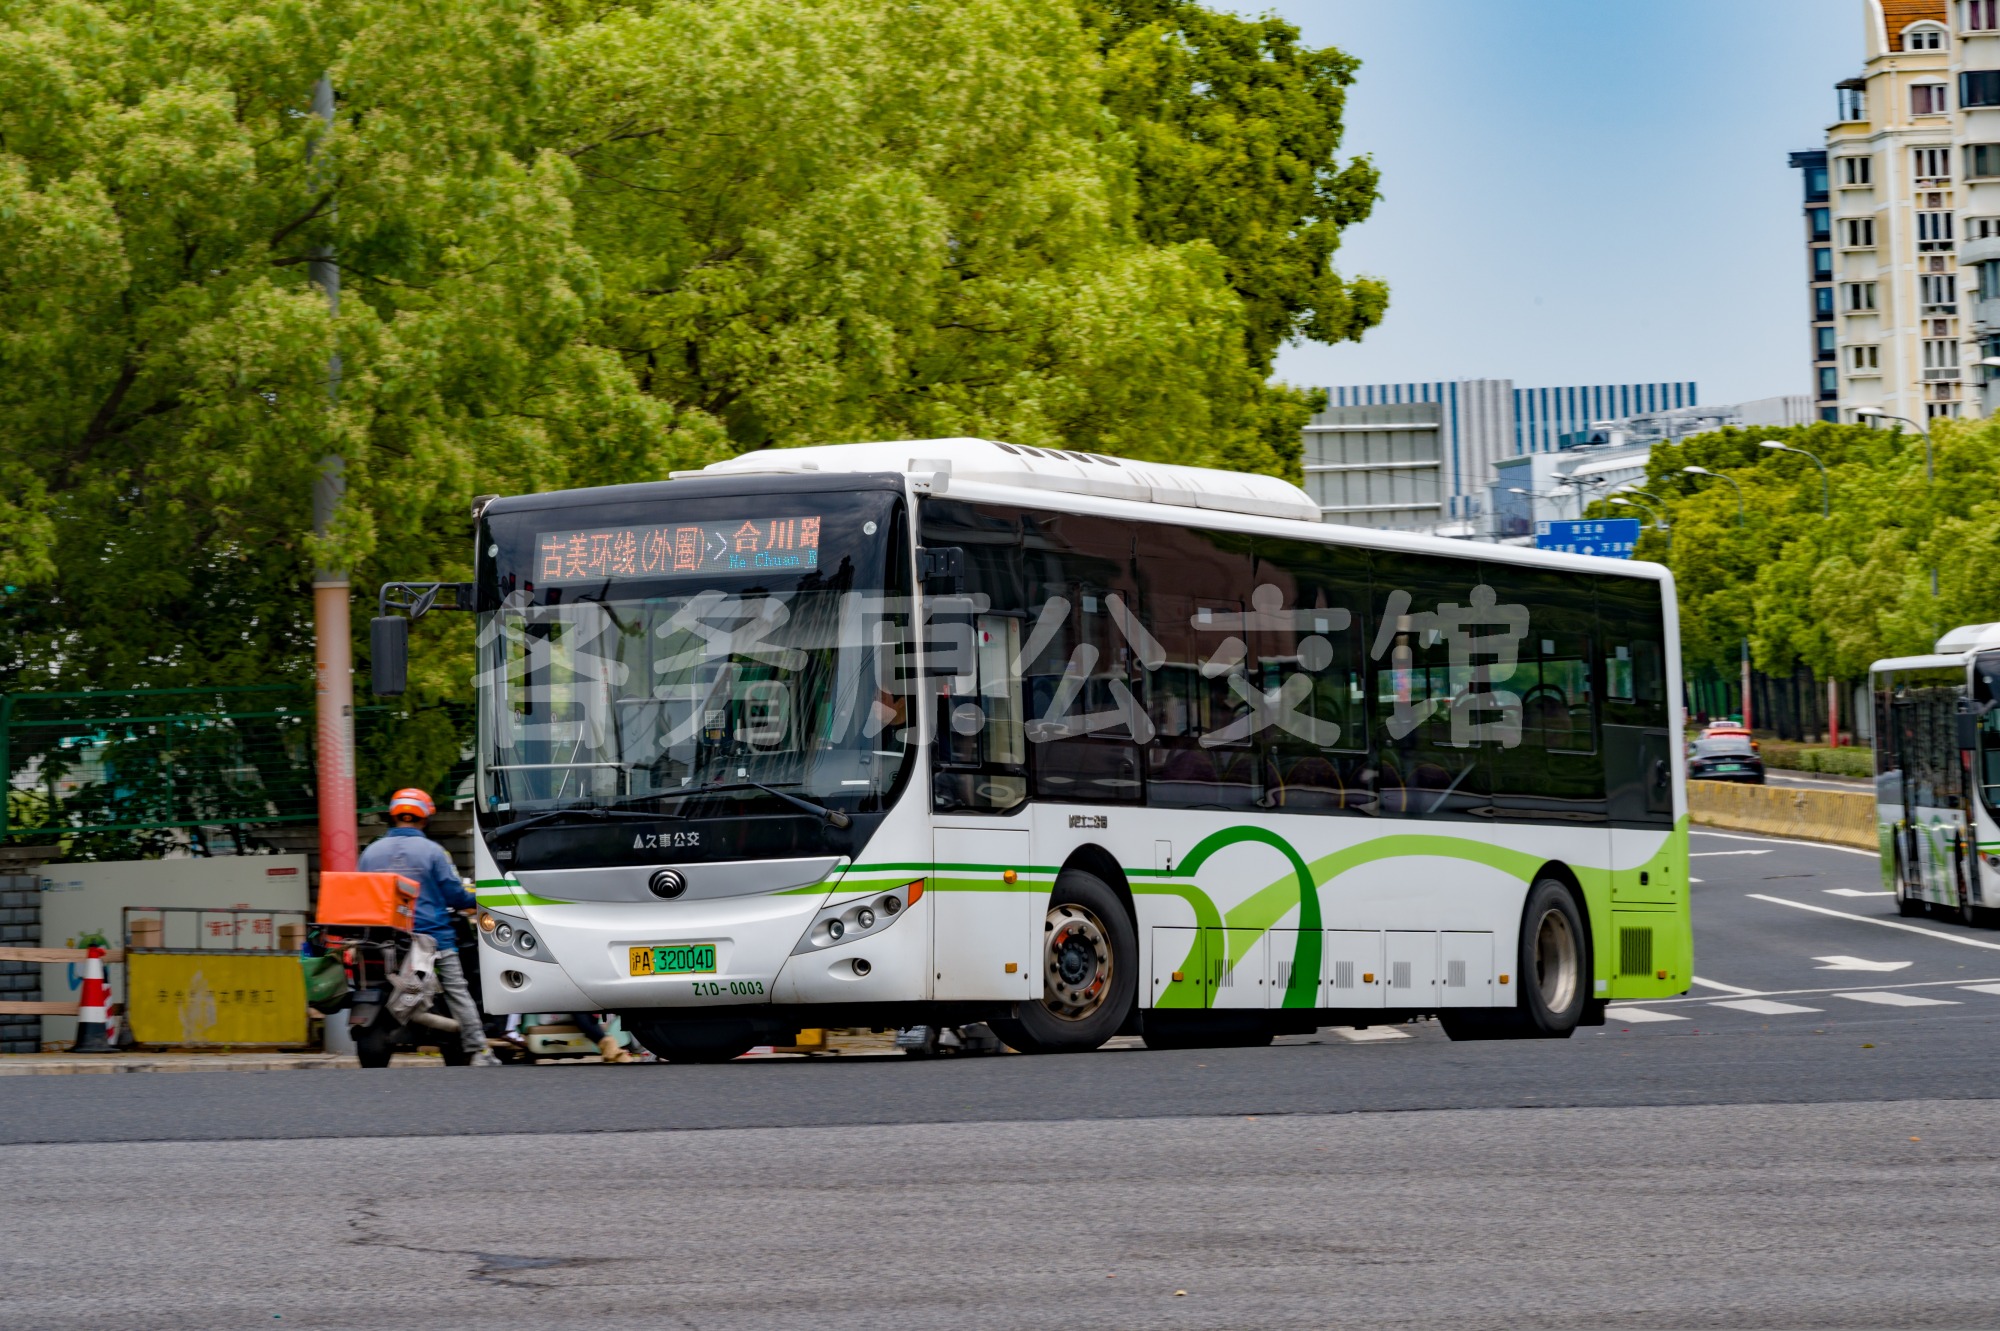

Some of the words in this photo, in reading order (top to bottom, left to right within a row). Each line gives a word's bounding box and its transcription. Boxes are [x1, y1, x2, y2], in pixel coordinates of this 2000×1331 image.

[729, 554, 746, 569] He
[755, 551, 800, 568] Chuan
[645, 831, 700, 849] 久事公交
[692, 981, 764, 996] Z1D-0003
